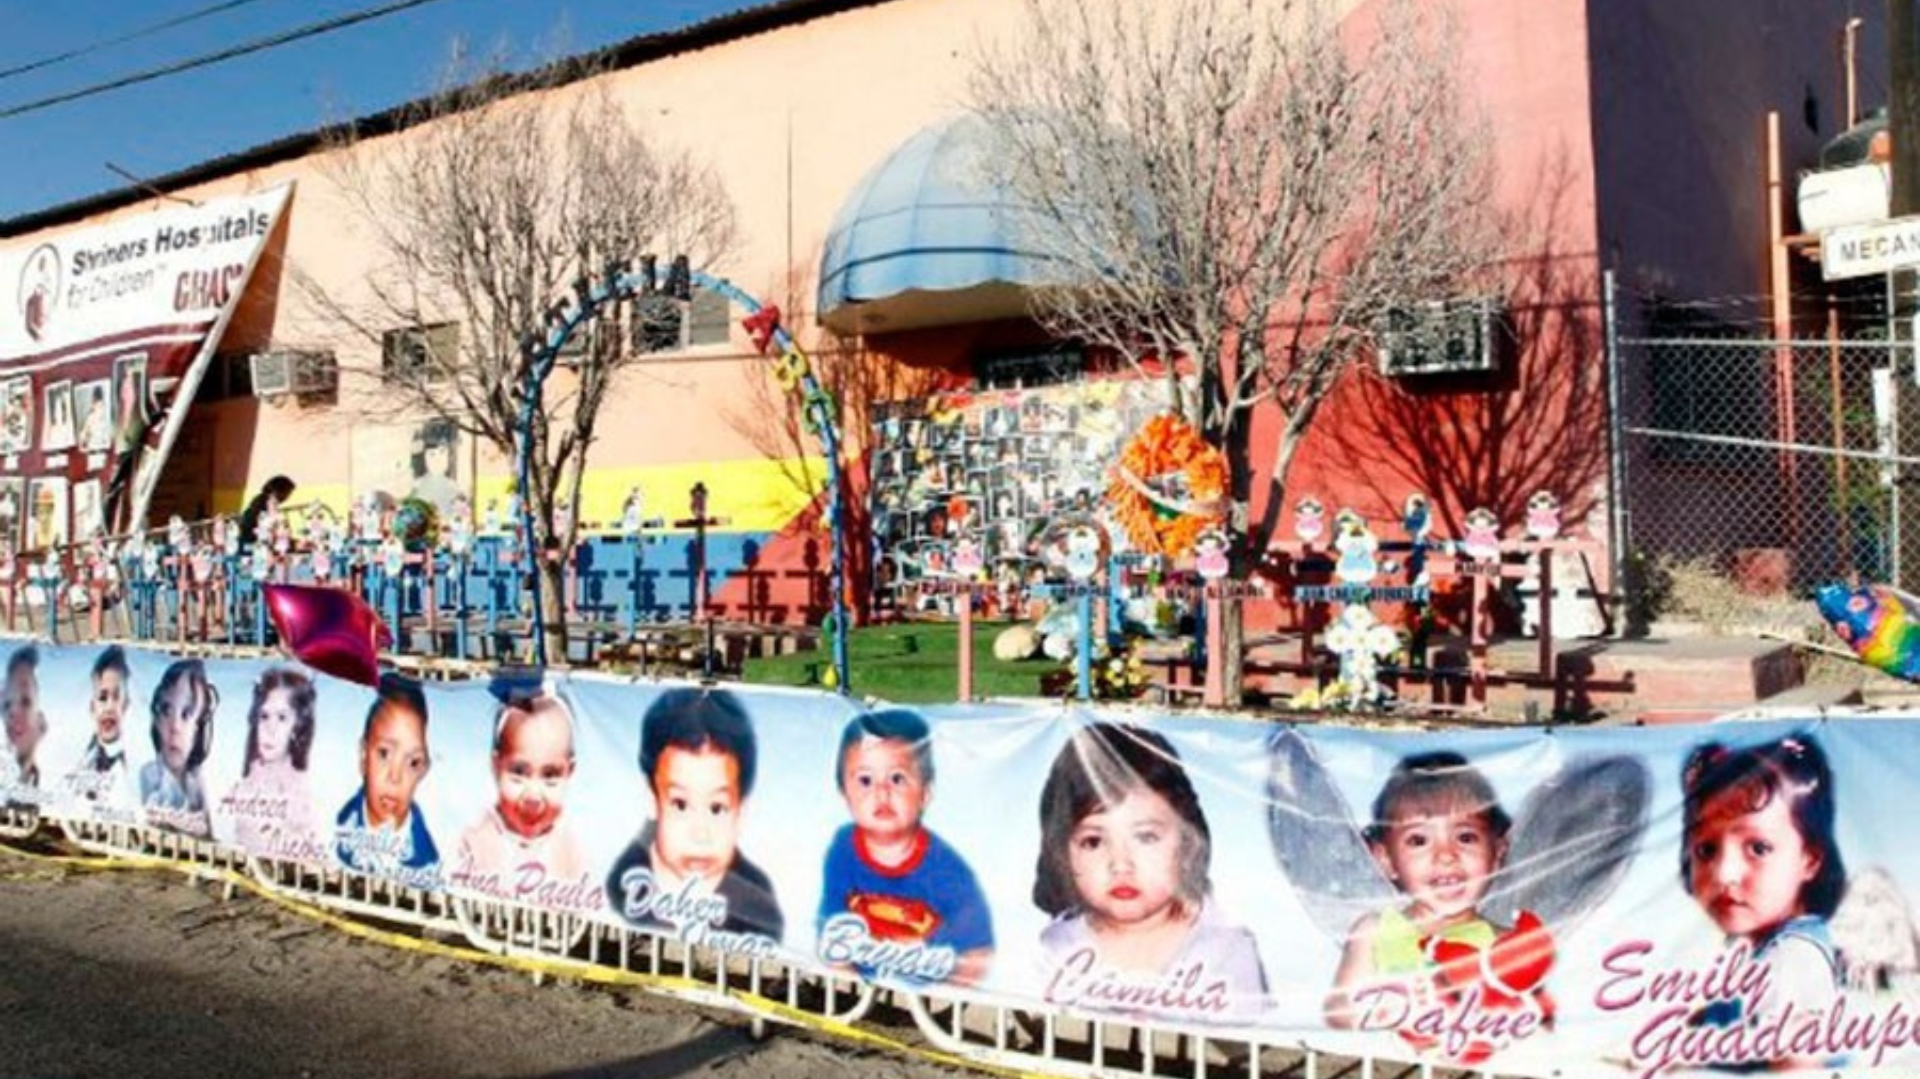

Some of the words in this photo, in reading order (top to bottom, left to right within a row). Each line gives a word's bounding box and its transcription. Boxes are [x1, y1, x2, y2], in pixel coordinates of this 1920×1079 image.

[515, 860, 605, 911] Paula
[824, 917, 953, 979] Bryan
[1593, 938, 1772, 1019] Emily
[1353, 981, 1538, 1057] Dafne
